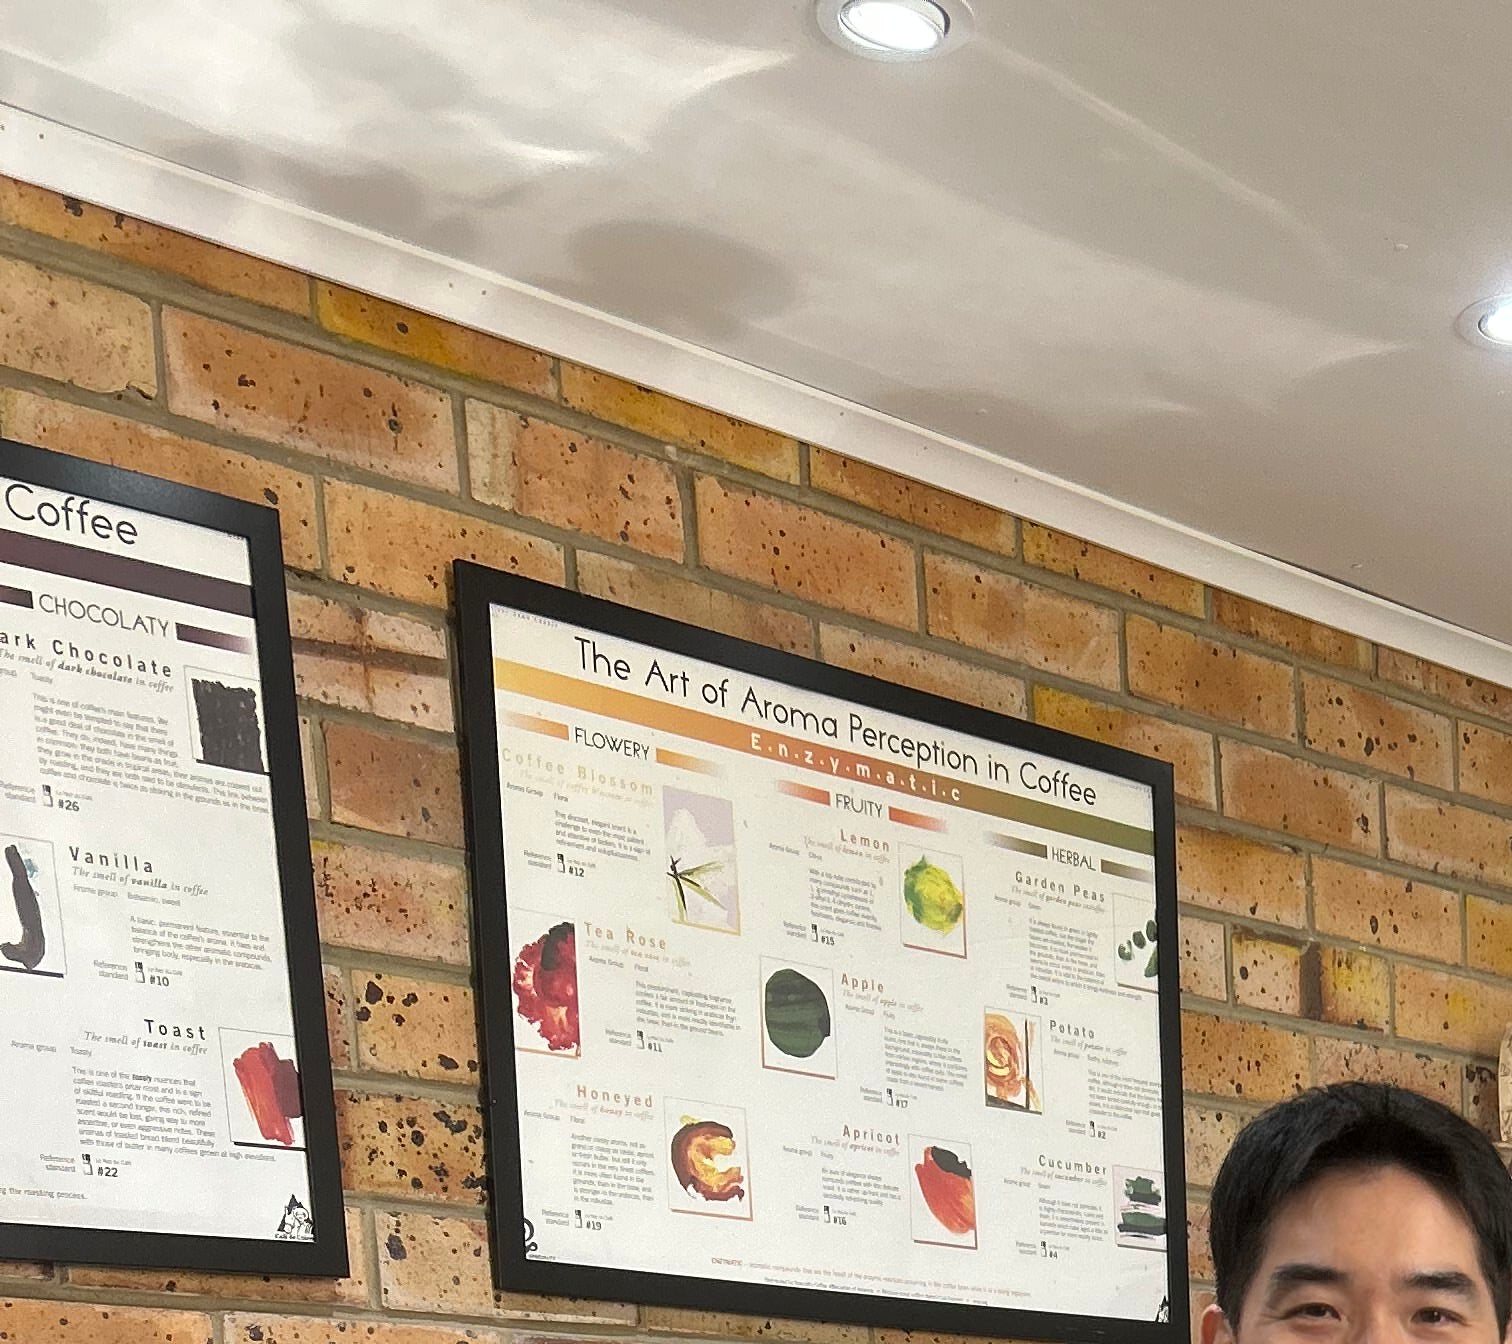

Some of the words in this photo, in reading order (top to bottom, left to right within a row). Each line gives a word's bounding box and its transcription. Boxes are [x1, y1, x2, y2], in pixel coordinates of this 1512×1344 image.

[6, 483, 138, 545] Coffee
[39, 594, 169, 637] CHOCOLATY
[52, 639, 172, 678] Chocolate
[58, 661, 83, 674] dark
[85, 666, 133, 684] chocolate
[149, 681, 174, 693] coffee
[574, 636, 631, 681] The
[644, 659, 690, 696] Art
[702, 678, 729, 708] of
[741, 686, 838, 738] Aroma
[849, 713, 978, 776] Perception
[988, 753, 1009, 784] in
[1020, 762, 1096, 807] Coffee
[574, 727, 650, 761] FLOWERY
[502, 748, 565, 775] Coffee
[577, 765, 653, 796] Blossom
[58, 799, 80, 812] #26
[835, 793, 883, 818] FRUITY
[840, 828, 890, 850] Lemon
[69, 846, 153, 873] Vanilla
[1051, 847, 1096, 871] HERBAL
[131, 877, 168, 889] vanilla
[183, 884, 209, 896] coffee
[1015, 870, 1065, 893] Garden
[1073, 884, 1105, 902] Peas
[584, 921, 614, 940] Tea
[626, 925, 666, 950] Rose
[149, 975, 170, 987] #10
[841, 973, 884, 992] Apple
[143, 1018, 206, 1041] Toast
[1049, 1019, 1095, 1039] Potato
[84, 1030, 103, 1042] The
[143, 1039, 168, 1050] toast
[183, 1043, 208, 1056] coffee
[577, 1084, 653, 1108] Honeyed
[843, 1124, 899, 1145] Apricot
[97, 1166, 119, 1178] #22
[1039, 1155, 1107, 1175] Cucumber
